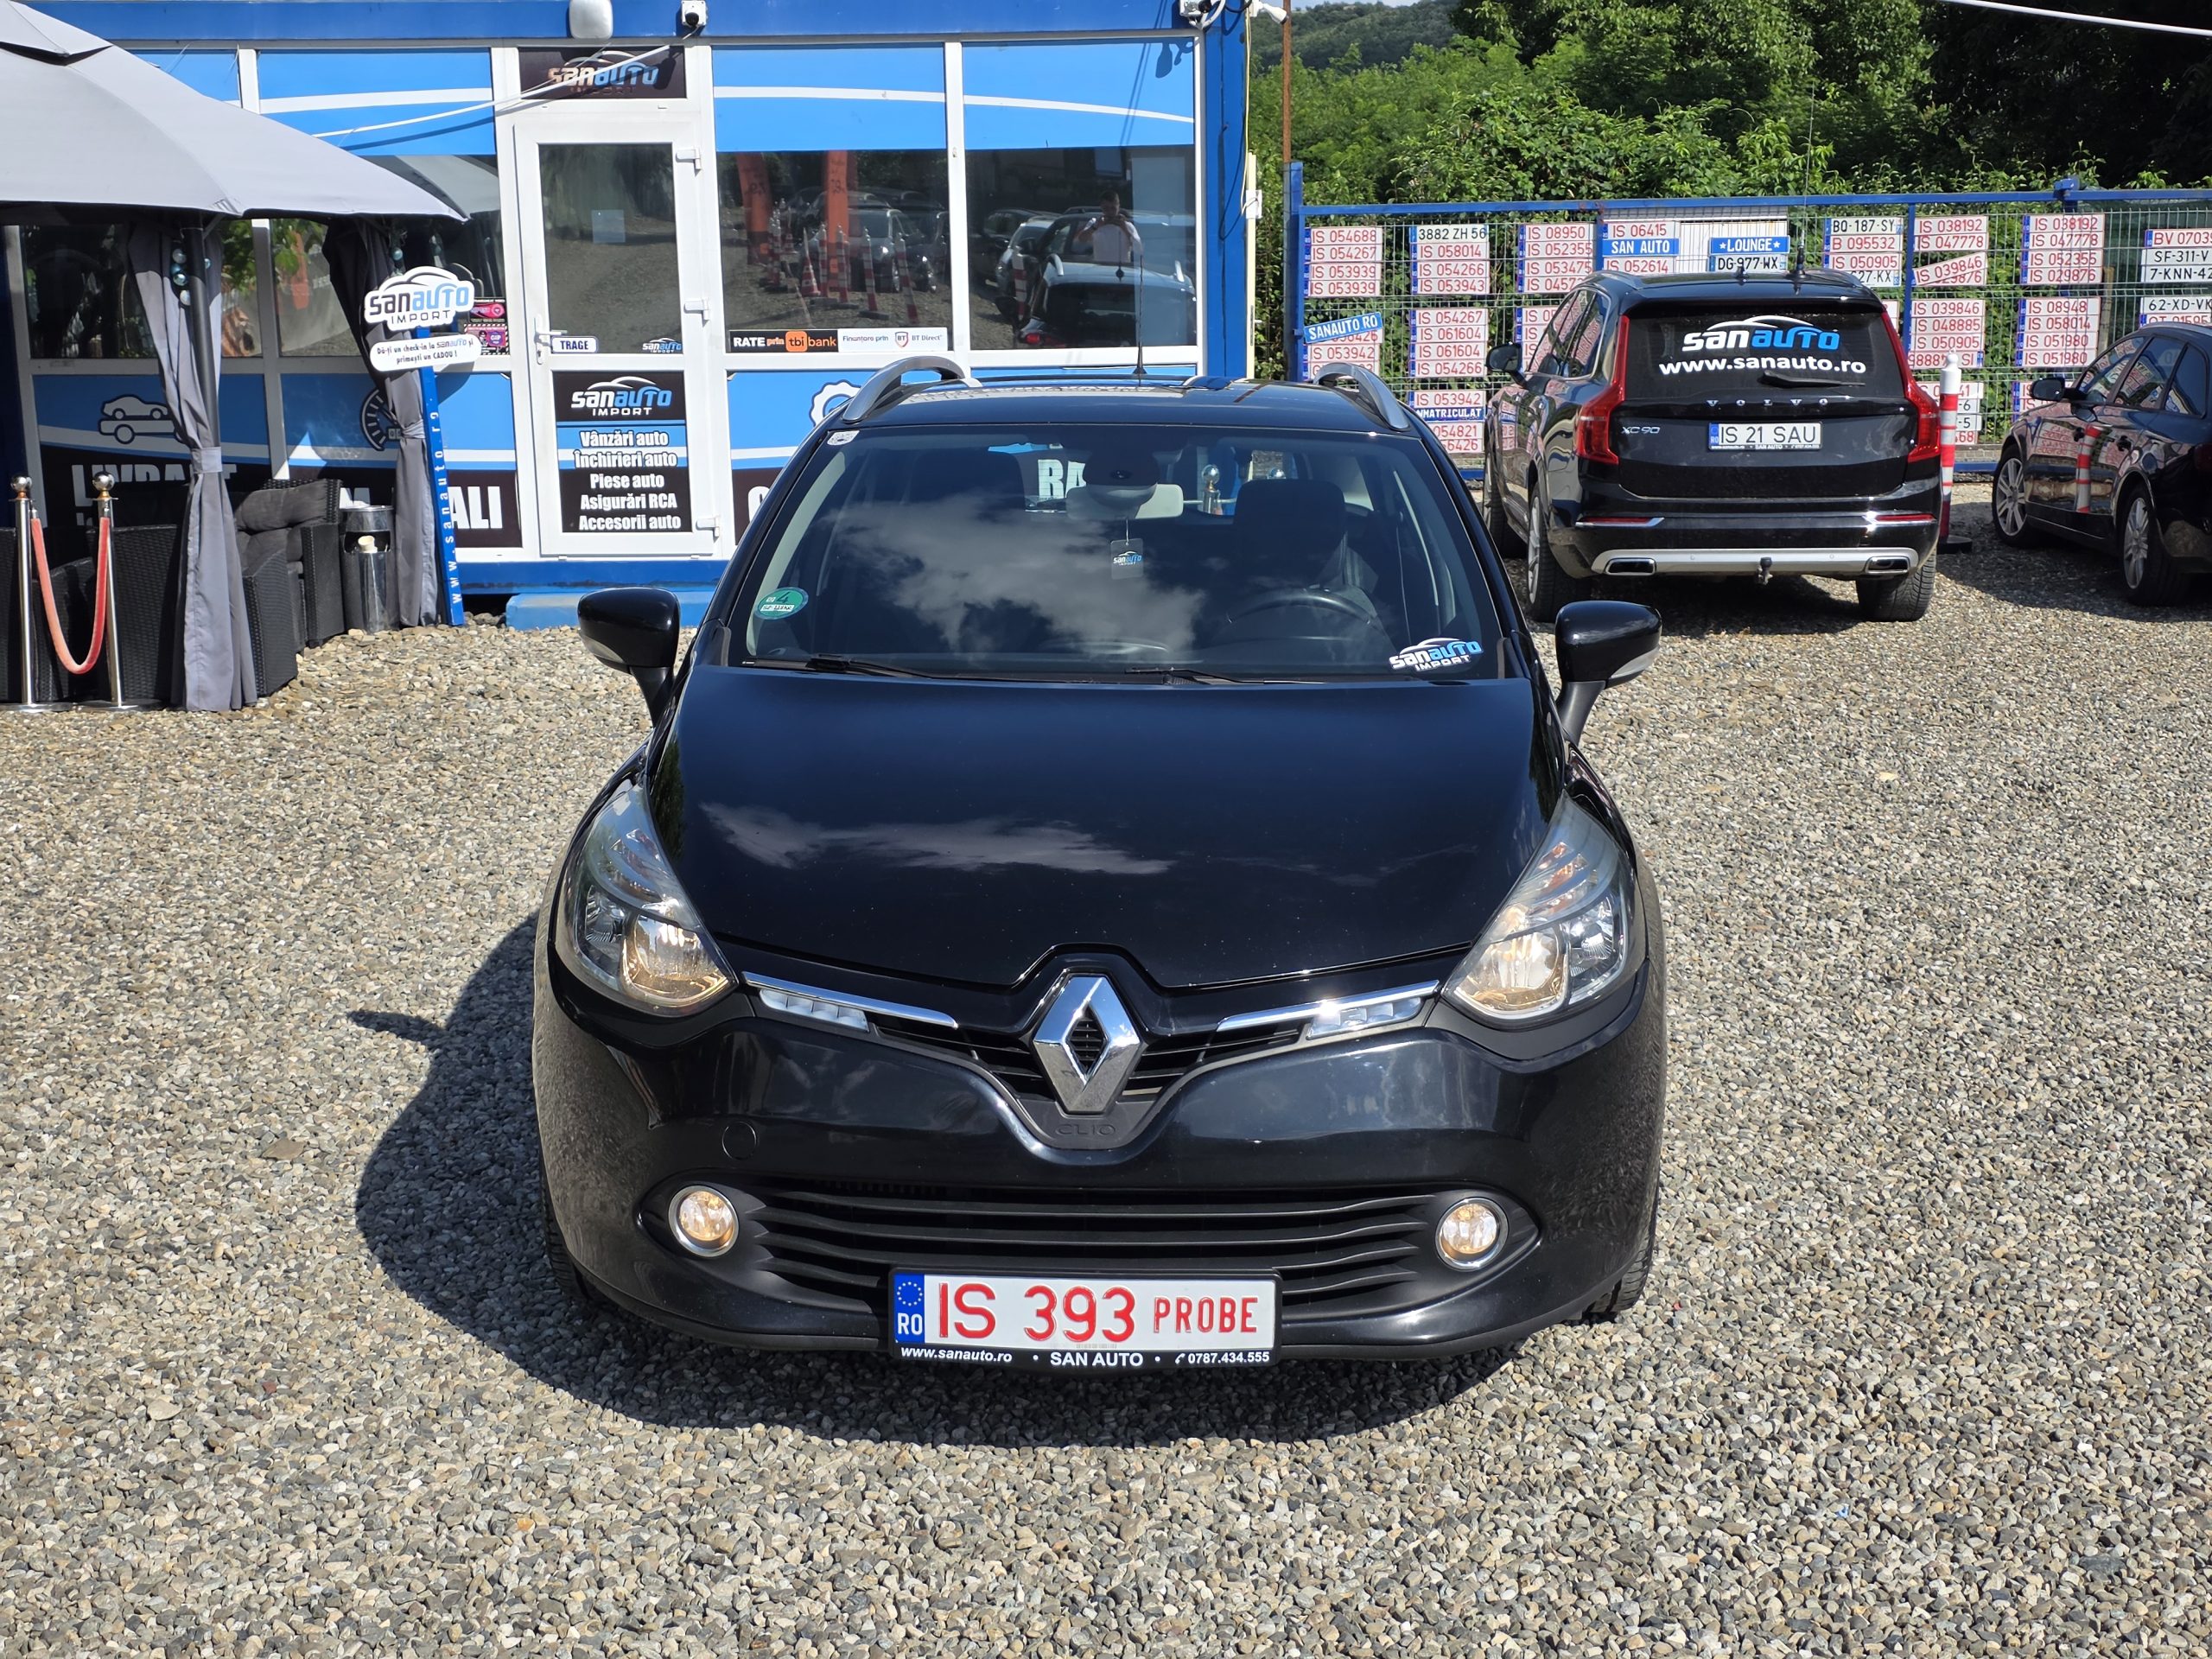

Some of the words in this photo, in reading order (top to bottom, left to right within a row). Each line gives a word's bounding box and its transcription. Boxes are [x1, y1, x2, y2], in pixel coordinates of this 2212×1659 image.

[1920, 220, 1932, 233] IS
[1937, 219, 1982, 232] 038192
[2035, 218, 2048, 231] IS
[2053, 217, 2098, 230] 038192
[1313, 231, 1325, 243] IS
[1330, 230, 1376, 243] 054688
[1419, 228, 1449, 240] 3882
[1452, 227, 1468, 239] ZH
[1471, 227, 1486, 239] 56
[1529, 226, 1541, 239] IS
[1546, 226, 1585, 239] 08950
[1613, 225, 1625, 238] IS
[1630, 224, 1667, 237] 06415
[1727, 238, 1773, 252] LOUNGE
[1833, 238, 1842, 250] B
[1847, 237, 1895, 250] 095532
[1917, 236, 1930, 249] IS
[1936, 235, 1984, 249] 047778
[2032, 234, 2044, 247] IS
[2050, 233, 2098, 247] 047778
[2154, 232, 2174, 245] BV
[1313, 247, 1325, 260] IS
[1330, 246, 1376, 259] 054267
[1421, 245, 1433, 258] IS
[1438, 245, 1481, 257] 058014
[1528, 243, 1541, 256] IS
[1545, 243, 1592, 256] 052355
[1611, 240, 1634, 254] SAN
[1640, 240, 1669, 253] AUTO
[1832, 257, 1845, 269] IS
[1850, 256, 1897, 269] 050905
[2031, 253, 2044, 266] IS
[2049, 252, 2096, 265] 052355
[2154, 250, 2209, 263] SF-311-V
[1420, 264, 1432, 276] IS
[1437, 263, 1484, 276] 054266
[1527, 262, 1540, 275] IS
[1544, 261, 1592, 274] 053475
[1607, 260, 1619, 270] IS
[1624, 259, 1669, 273] 052614
[1718, 257, 1777, 270] DG-977-WX
[1916, 269, 1930, 283] IS
[1935, 256, 1982, 278] 039846
[1313, 265, 1325, 278] IS
[1329, 265, 1376, 278] 053939
[2030, 270, 2043, 283] IS
[2048, 269, 2095, 282] 029876
[1311, 282, 1323, 295] IS
[1328, 282, 1376, 295] 053939
[1421, 279, 1433, 292] IS
[1437, 279, 1485, 292] 053943
[1527, 278, 1540, 291] IS
[1914, 302, 1927, 315] IS
[1932, 302, 1980, 315] 039846
[2029, 301, 2042, 314] IS
[2047, 301, 2088, 314] 08948
[391, 309, 451, 324] IMPORT
[1419, 311, 1431, 324] IS
[1435, 310, 1483, 324] 054267
[1525, 309, 1537, 322] IS
[1308, 318, 1360, 340] SANAUTO
[1362, 315, 1377, 329] RO
[1932, 319, 1980, 331] 048885
[2028, 317, 2042, 330] IS
[2046, 317, 2090, 330] 058014
[734, 337, 765, 346] RATE
[767, 336, 785, 346] prin
[790, 334, 805, 346] tbi
[809, 334, 836, 346] bank
[1421, 327, 1433, 340] IS
[1438, 327, 1481, 340] 061604
[1525, 327, 1537, 340] IS
[560, 340, 588, 350] TRAGE
[1932, 336, 1980, 349] 050905
[2026, 334, 2039, 347] IS
[2044, 334, 2088, 347] 051980
[1327, 346, 1375, 359] 053942
[1420, 345, 1431, 358] IS
[1436, 344, 1480, 358] 061604
[1658, 355, 1866, 375] www.sanauto.ro
[2025, 353, 2037, 365] IS
[2043, 352, 2088, 365] 051980
[1417, 362, 1430, 375] IS
[1434, 362, 1482, 375] 054266
[1417, 393, 1429, 406] IS
[1433, 393, 1481, 406] 053942
[1707, 398, 1828, 407] VOLVO
[593, 408, 652, 416] IMPORT
[580, 430, 633, 447] Vânzări
[636, 432, 669, 447] auto
[1720, 426, 1738, 443] IS
[1745, 426, 1763, 443] 21
[1773, 426, 1815, 443] SAU
[574, 449, 642, 468] Închirieri
[645, 452, 677, 467] auto
[590, 474, 630, 489] Piese
[632, 474, 664, 488] auto
[581, 493, 645, 511] Asigurări
[649, 493, 677, 508] RCA
[579, 515, 646, 531] Accesorii
[649, 516, 682, 530] auto
[1414, 655, 1471, 672] IMPORT
[1056, 1123, 1116, 1135] CLIO
[898, 1313, 923, 1336] RO
[938, 1282, 996, 1338] IS
[1024, 1285, 1135, 1343] 393
[1153, 1296, 1259, 1334] PROBE
[900, 1346, 1013, 1363] www.sanauto.ro
[1050, 1351, 1088, 1366] SAN
[1092, 1352, 1143, 1366] AUTO
[1187, 1351, 1270, 1364] 0787.434.555
